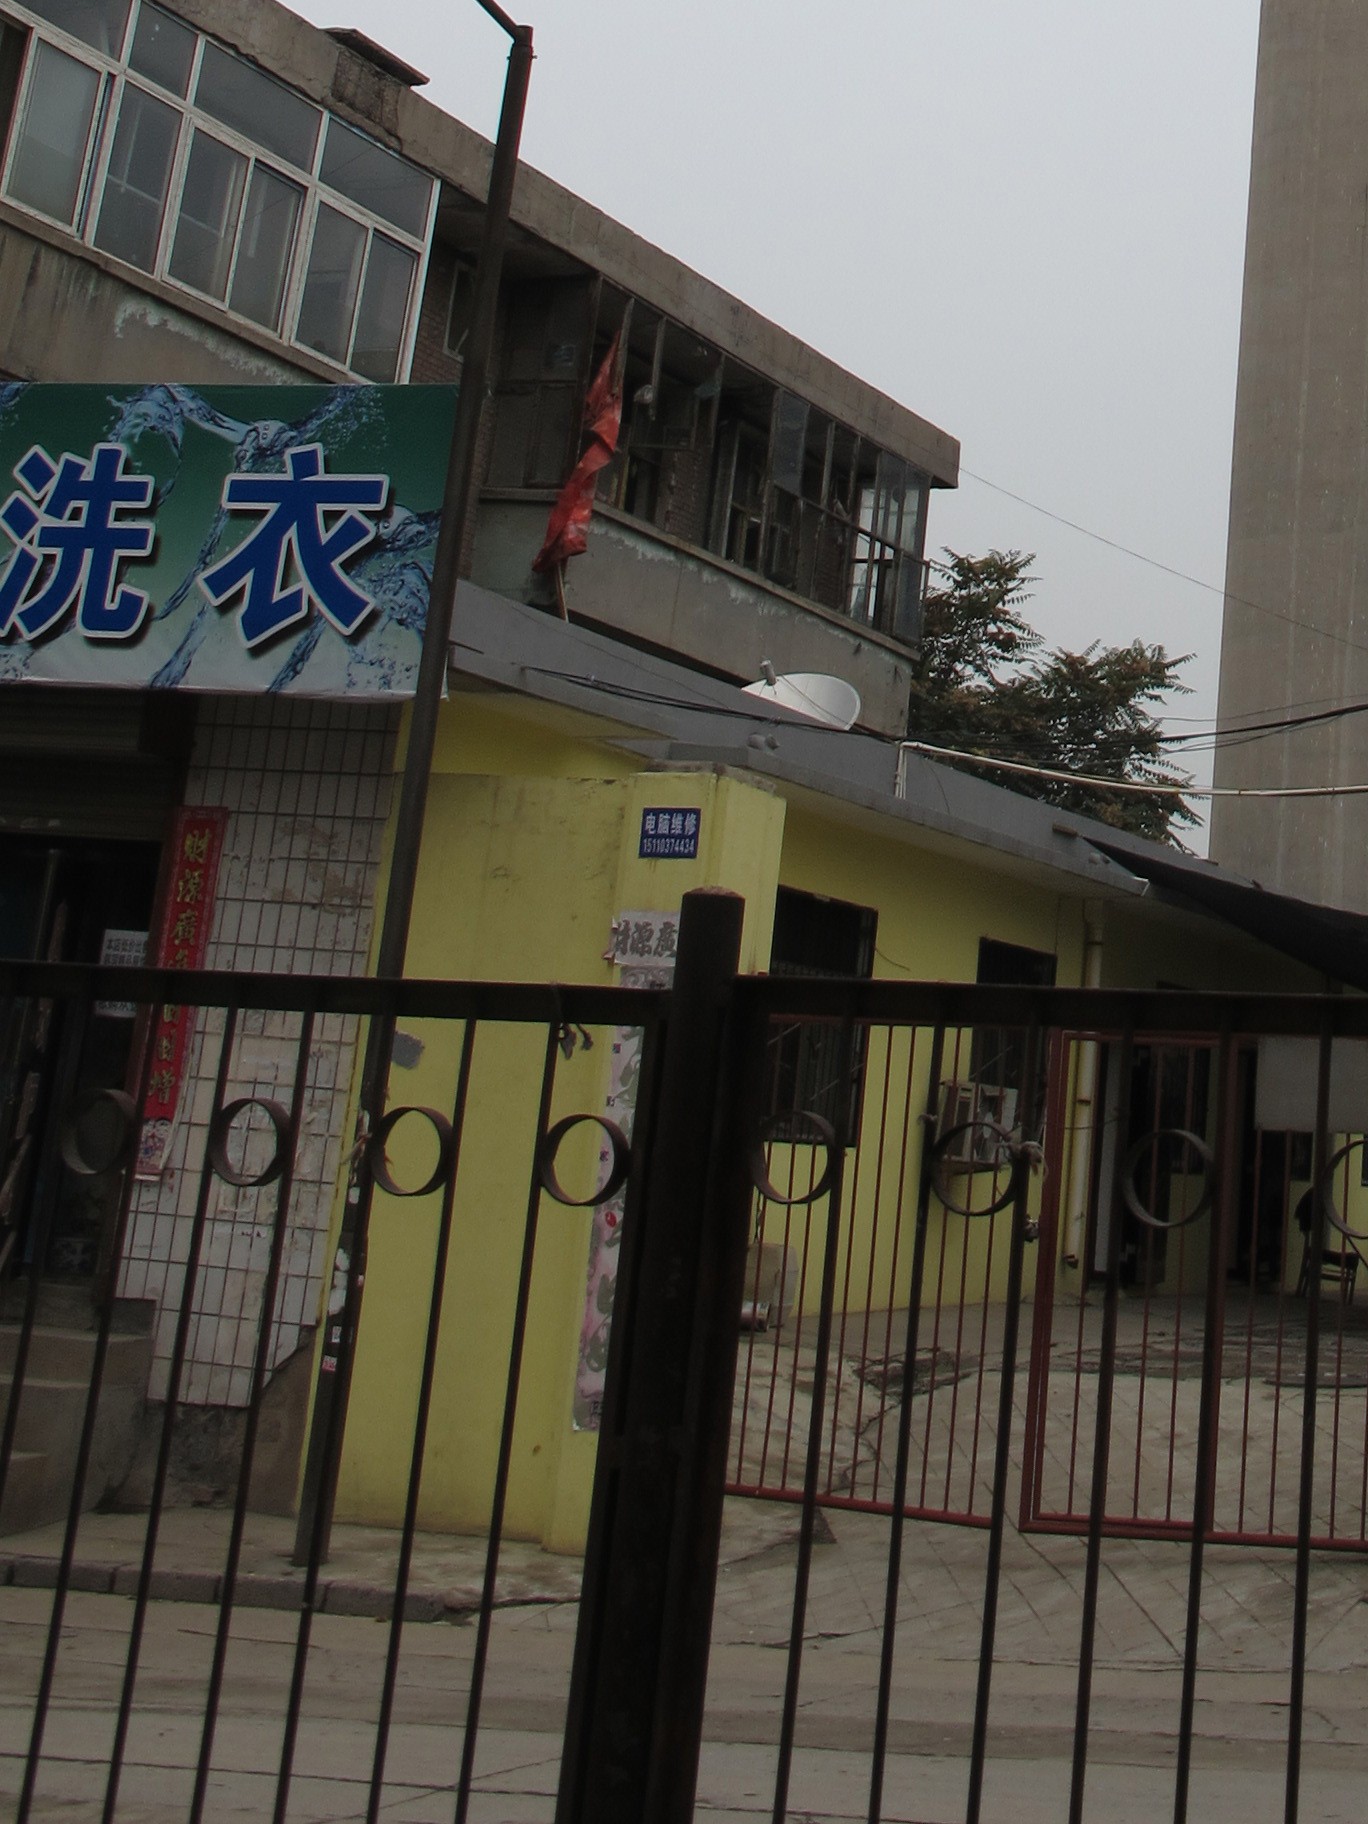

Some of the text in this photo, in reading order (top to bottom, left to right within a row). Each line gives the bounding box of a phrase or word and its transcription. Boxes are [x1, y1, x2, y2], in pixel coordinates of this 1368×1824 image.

[0, 442, 391, 649] 洗衣
[644, 812, 698, 836] 电脑维修
[643, 838, 695, 854] 15110374434
